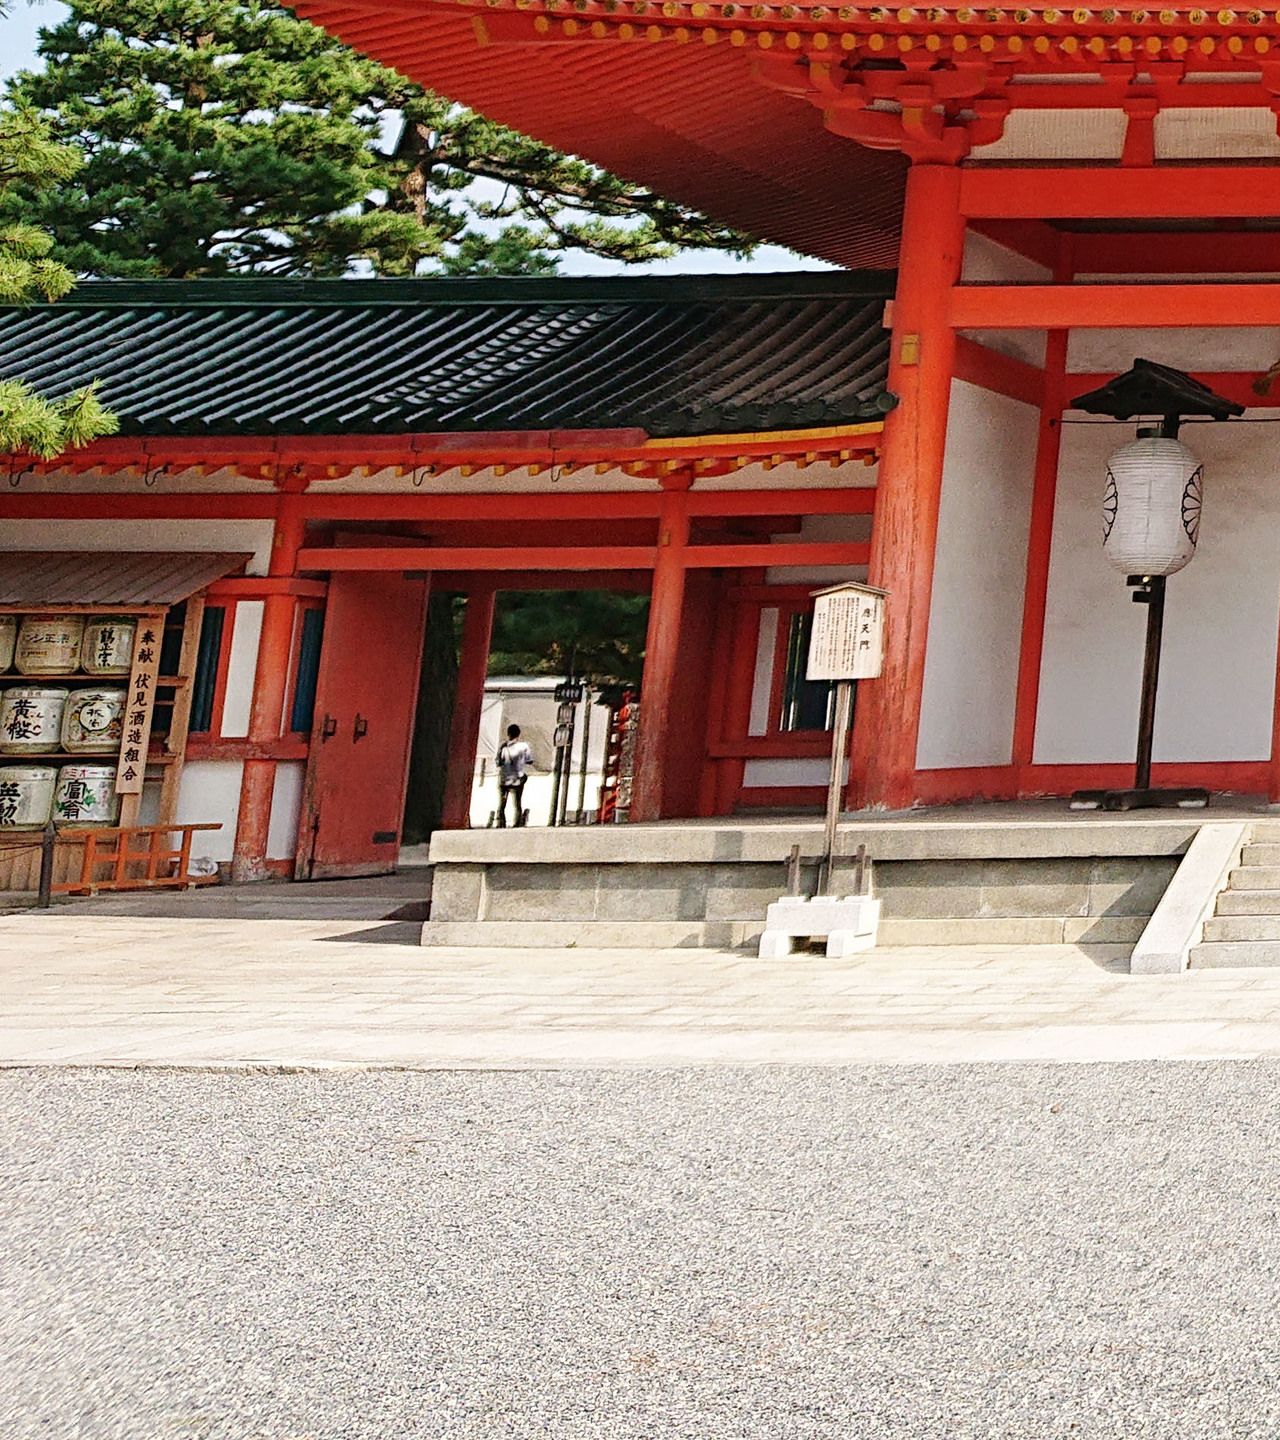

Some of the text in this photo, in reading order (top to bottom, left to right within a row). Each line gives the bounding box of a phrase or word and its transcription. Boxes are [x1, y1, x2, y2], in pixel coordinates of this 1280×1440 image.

[122, 629, 155, 781] 奉献 伏見酒造組合
